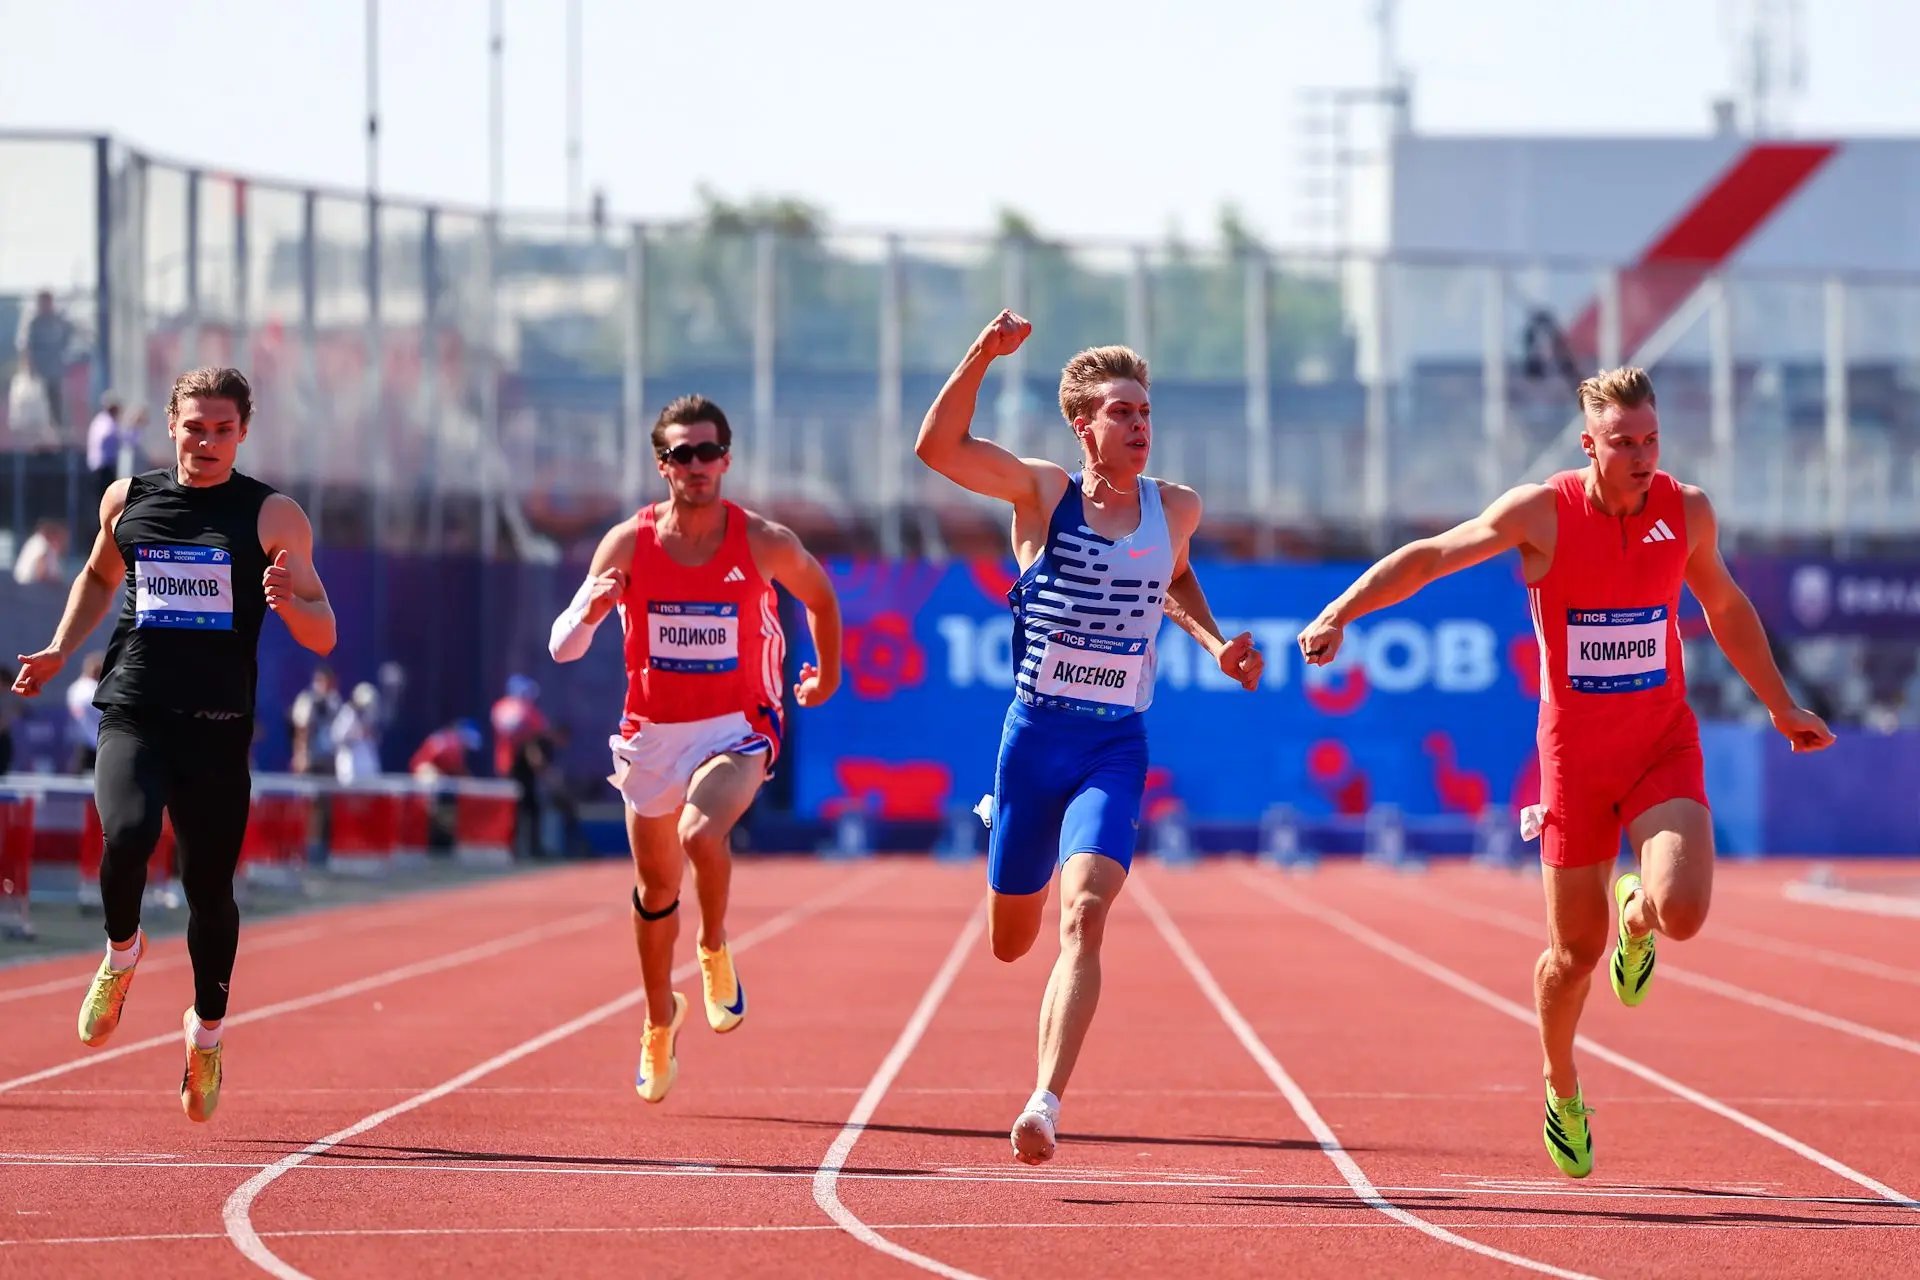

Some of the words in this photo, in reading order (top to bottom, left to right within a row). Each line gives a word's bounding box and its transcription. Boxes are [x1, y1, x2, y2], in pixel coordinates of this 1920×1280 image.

[148, 549, 171, 559] ПСБ
[147, 576, 220, 597] НОВИКОВ
[1583, 613, 1607, 623] ПСБ
[659, 626, 727, 647] РОДИКОВ
[1062, 633, 1086, 646] ПСБ
[1090, 638, 1125, 647] ЧЕМПИОНАТ
[1088, 643, 1112, 651] РОССИИ
[1580, 638, 1656, 661] КОМАРОВ
[1052, 660, 1127, 689] АКСЕНОВ
